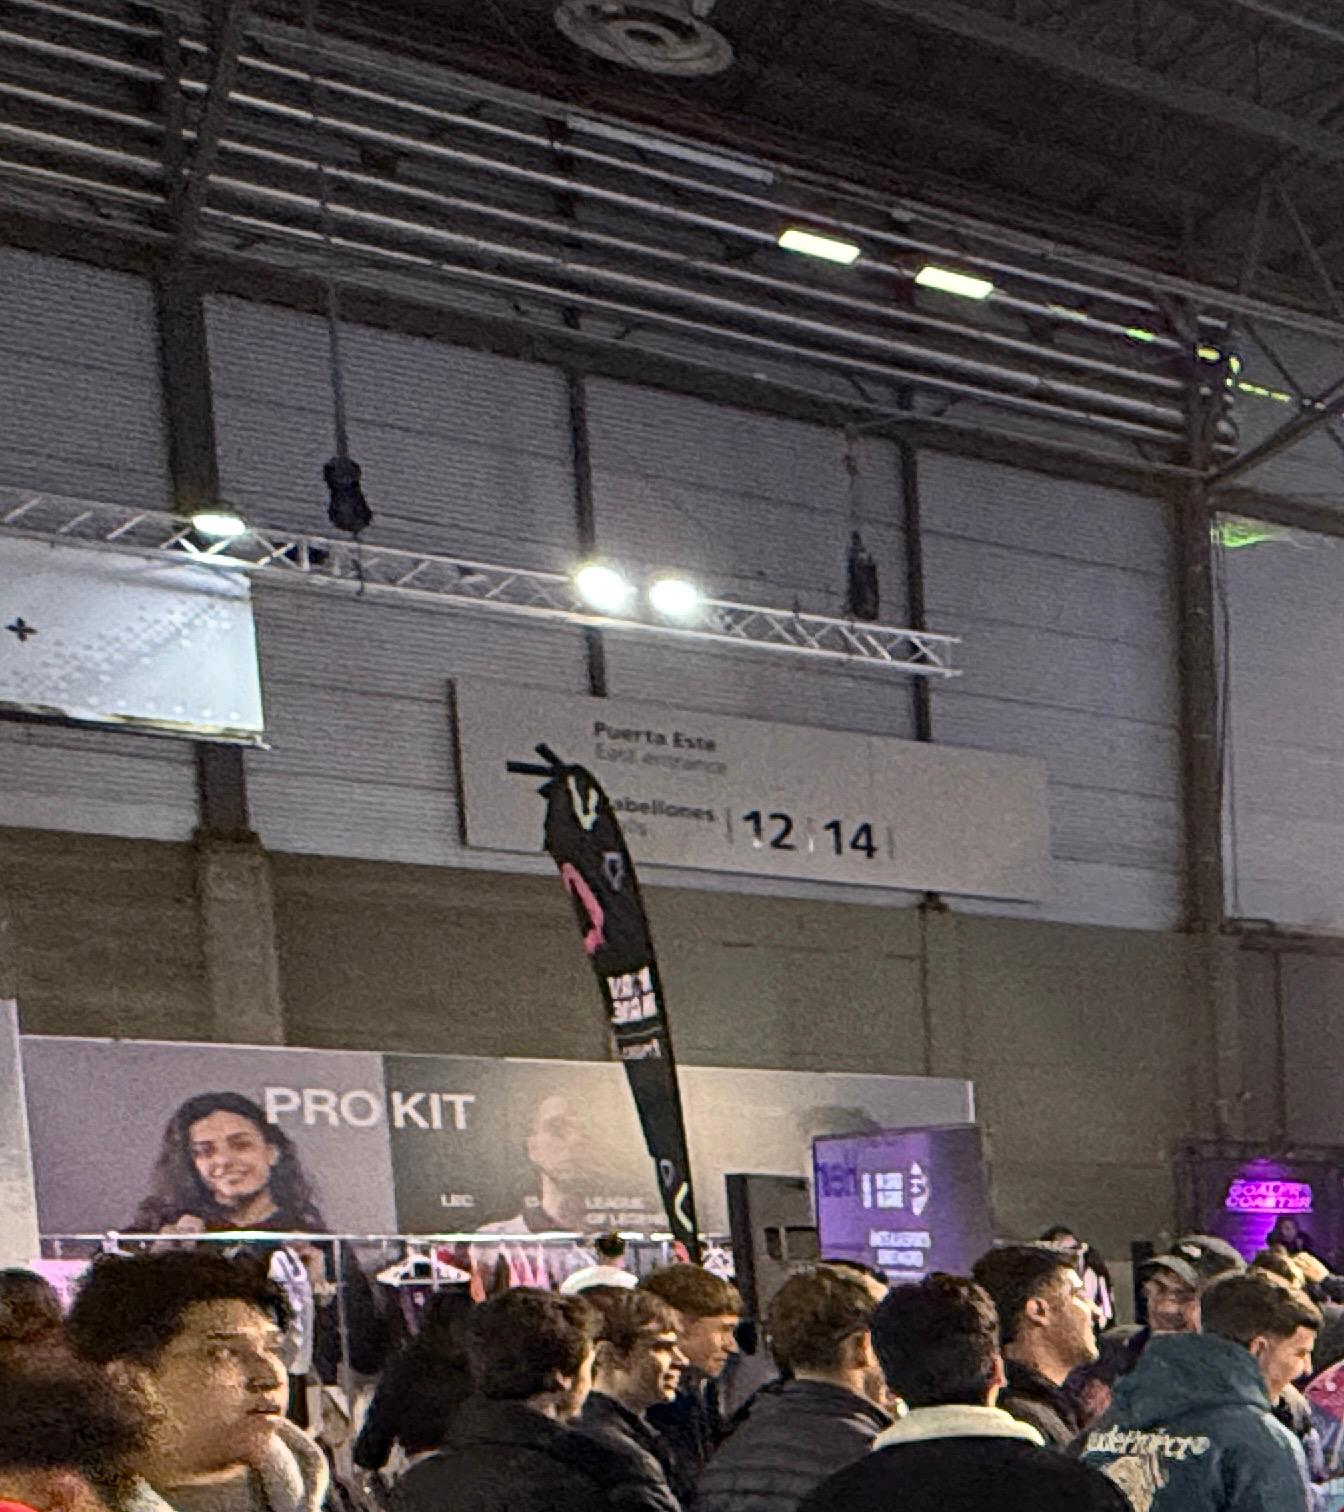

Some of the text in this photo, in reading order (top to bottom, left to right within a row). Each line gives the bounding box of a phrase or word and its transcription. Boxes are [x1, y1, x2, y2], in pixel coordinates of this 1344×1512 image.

[594, 720, 717, 752] Puerta Este
[612, 797, 878, 859] abellones 12 14
